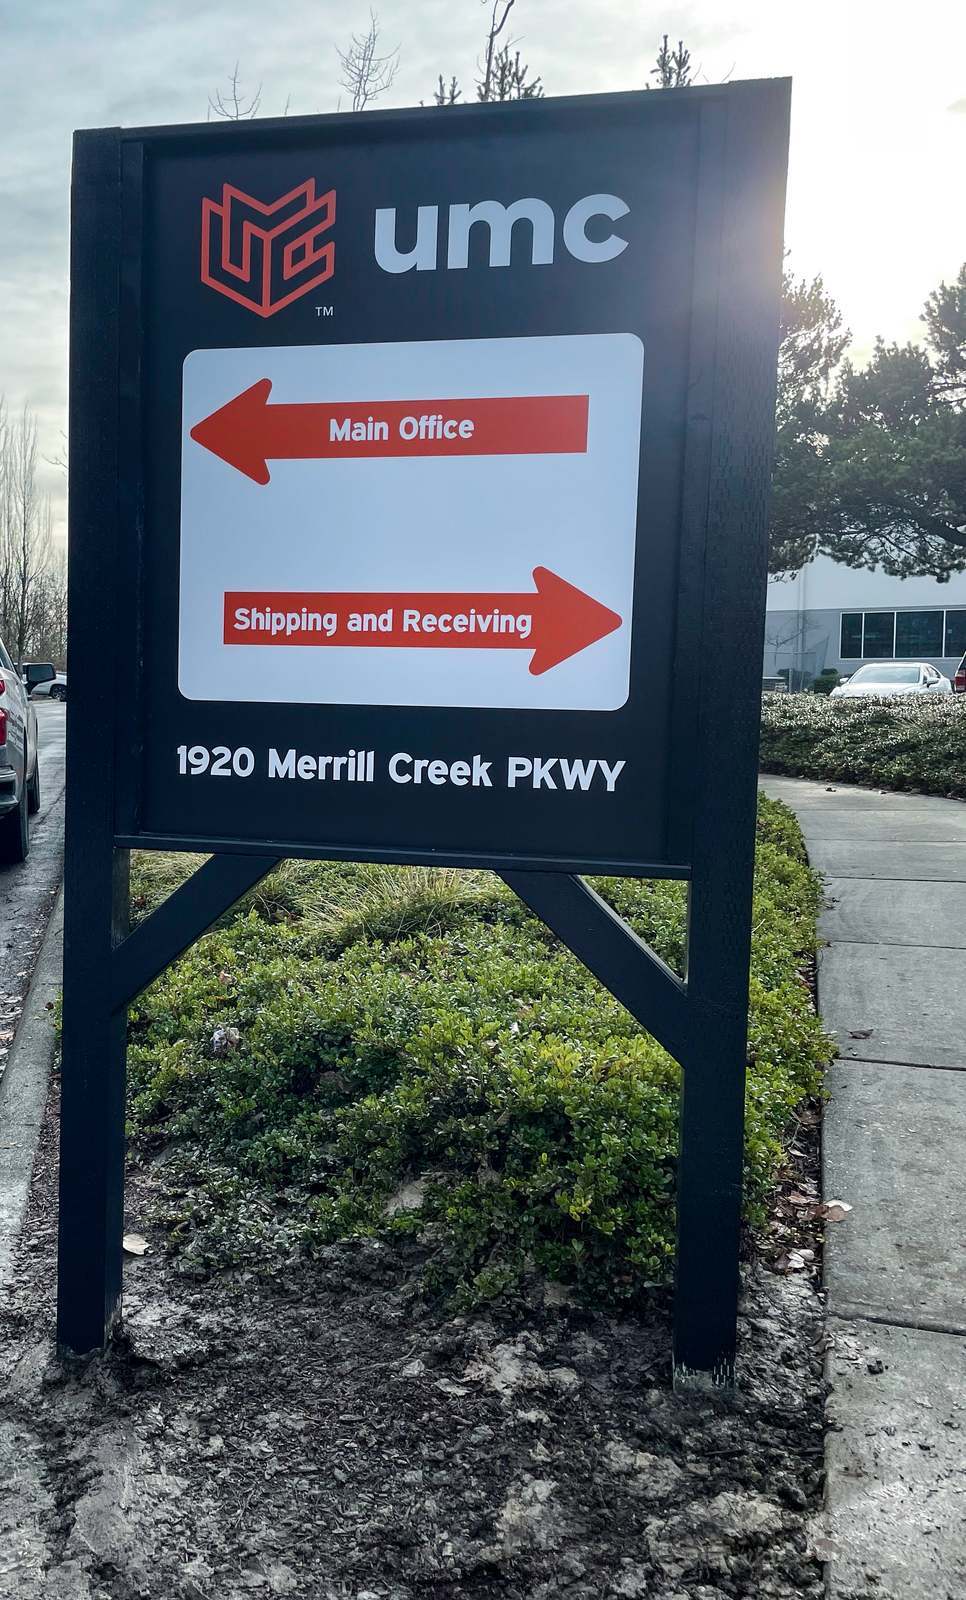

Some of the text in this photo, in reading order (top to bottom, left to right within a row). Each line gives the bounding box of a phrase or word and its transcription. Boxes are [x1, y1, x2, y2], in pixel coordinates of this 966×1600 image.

[375, 193, 631, 273] umc
[329, 414, 475, 442] Main Office
[233, 608, 533, 639] Shipping and Receiving
[176, 745, 626, 792] 1920 Merrill Creek PKWY
